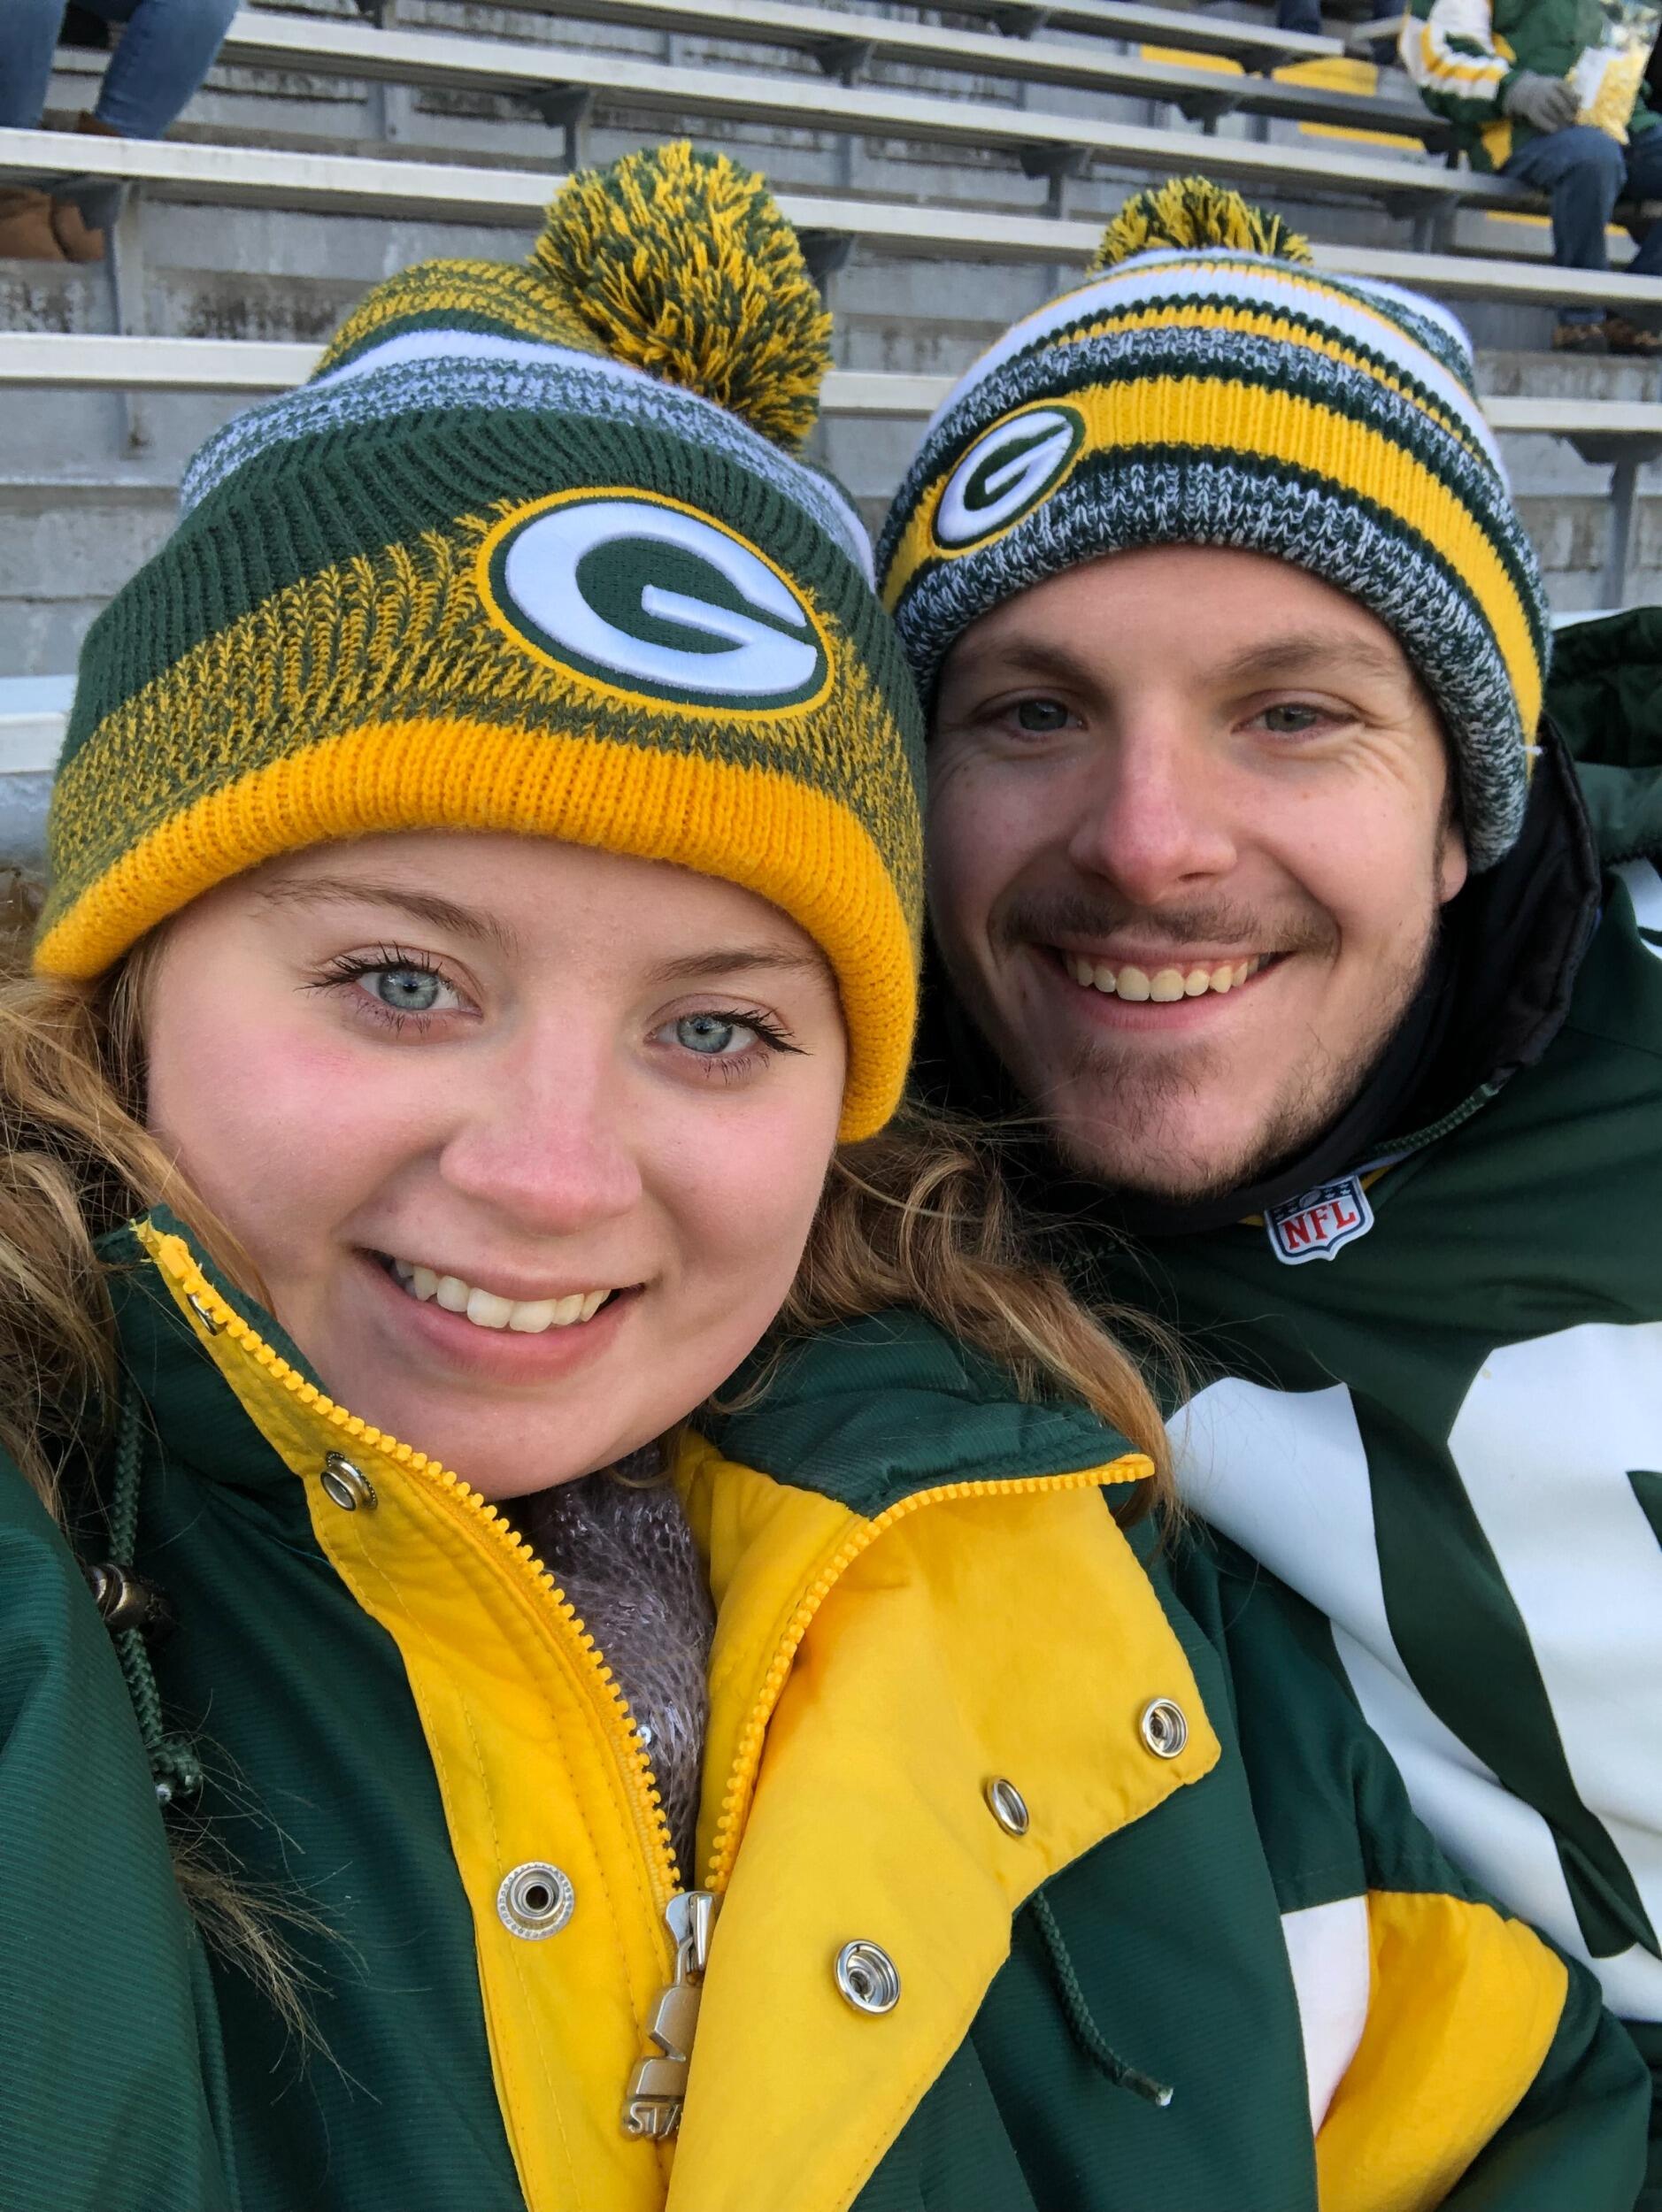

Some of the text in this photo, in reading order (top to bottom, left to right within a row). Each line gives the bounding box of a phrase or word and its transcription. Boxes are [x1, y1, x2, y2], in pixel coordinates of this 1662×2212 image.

[937, 411, 1073, 541] G
[505, 502, 818, 696] G
[1282, 1201, 1357, 1250] NFL
